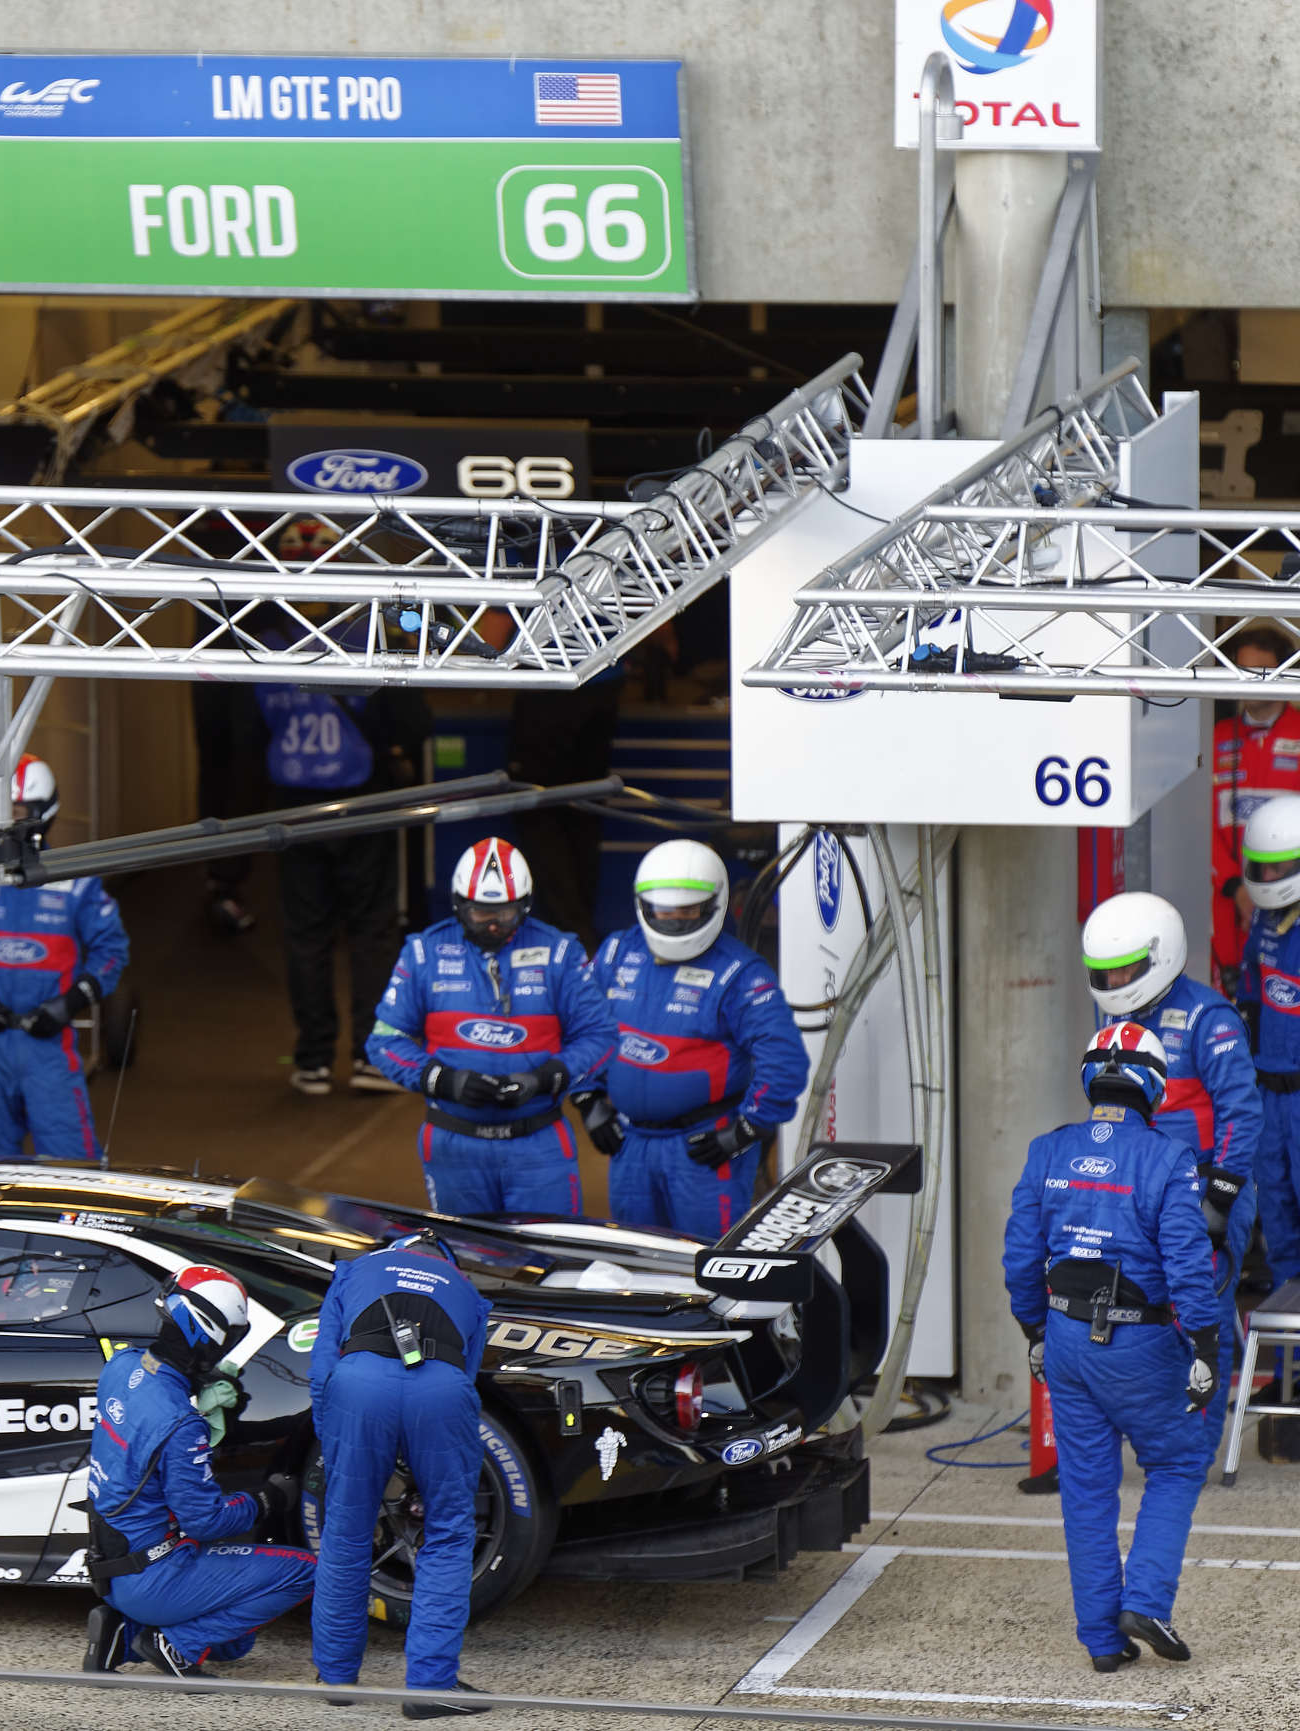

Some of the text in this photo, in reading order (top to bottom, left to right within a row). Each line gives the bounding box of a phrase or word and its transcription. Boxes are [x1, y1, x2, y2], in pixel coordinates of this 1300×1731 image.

[0, 78, 101, 104] WEC
[212, 74, 402, 121] LM GTE PRO
[913, 92, 1081, 127] OTAL
[128, 184, 298, 258] FORD
[524, 183, 647, 263] 66
[313, 456, 399, 491] Ford
[457, 456, 575, 498] 66
[1034, 756, 1113, 808] 66
[469, 1021, 516, 1046] Ford
[620, 1035, 658, 1062] Ford
[1079, 1157, 1109, 1177] Ford
[1045, 1178, 1069, 1190] FORD
[702, 1256, 799, 1282] GT
[487, 1320, 638, 1360] DGE
[731, 1443, 756, 1463] Ford
[207, 1546, 253, 1557] FORD
